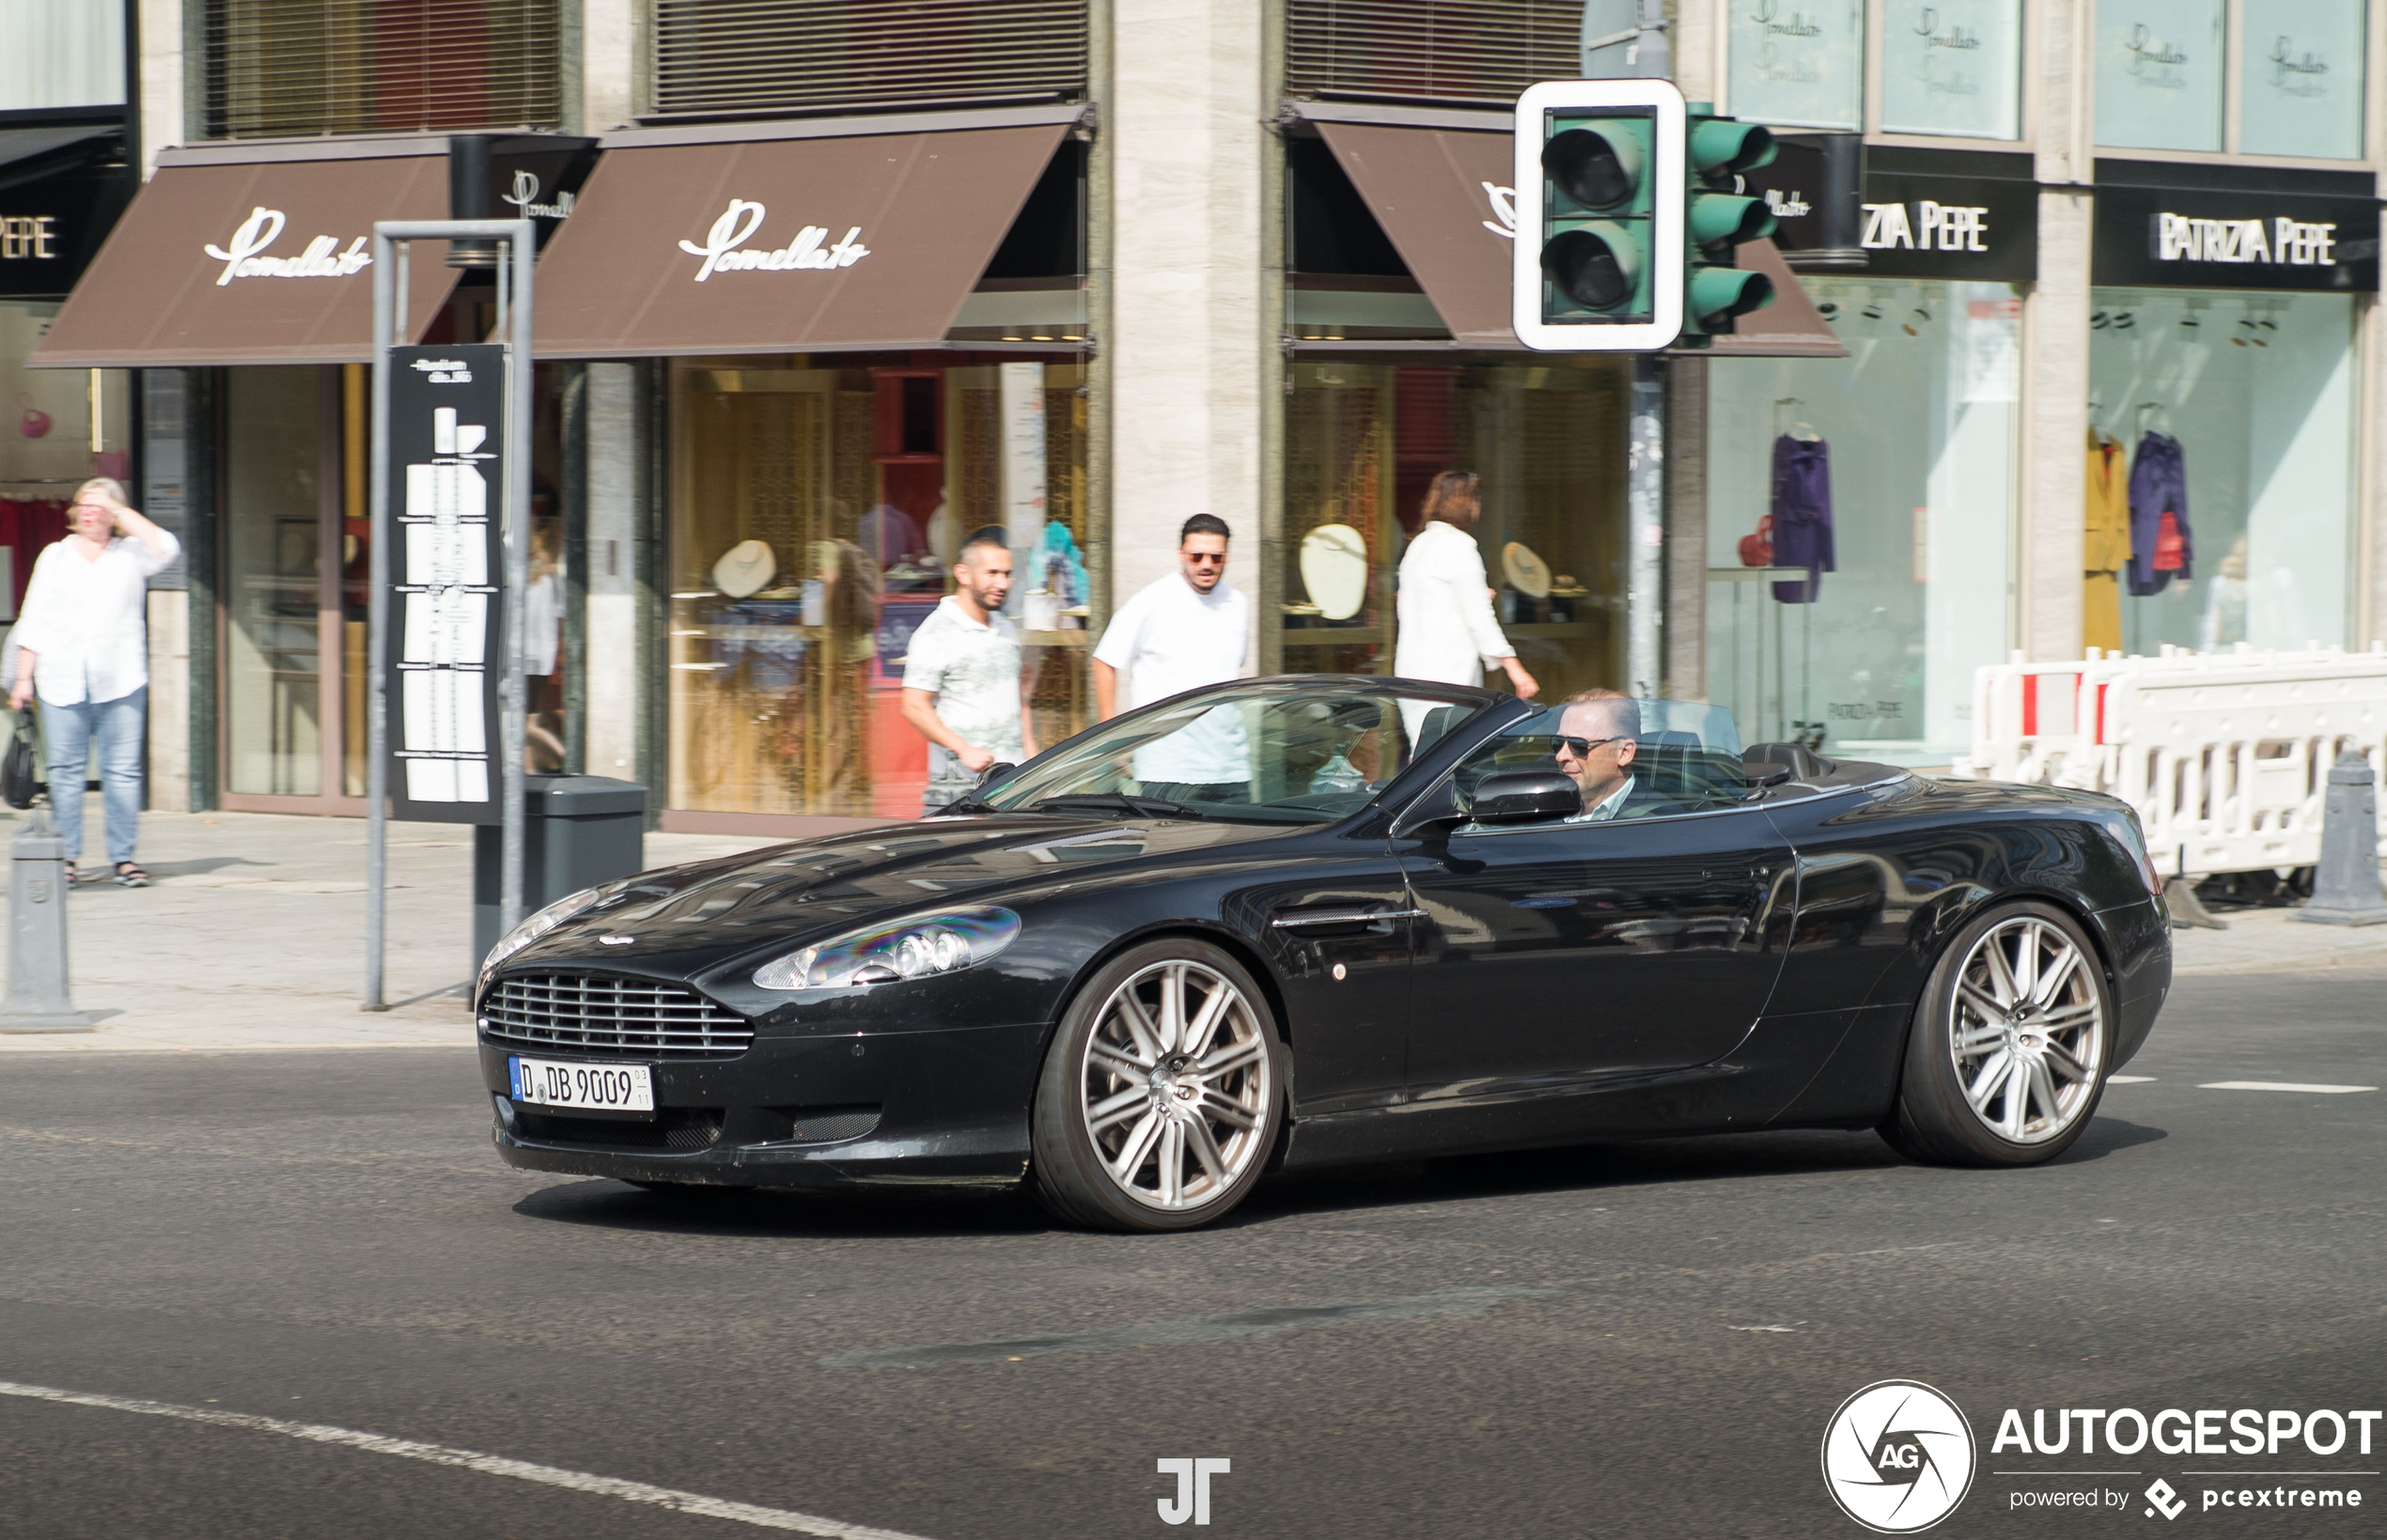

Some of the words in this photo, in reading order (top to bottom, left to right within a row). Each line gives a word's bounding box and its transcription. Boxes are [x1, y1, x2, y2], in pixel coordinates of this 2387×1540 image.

[204, 207, 374, 287] Pomellato
[678, 198, 871, 282] Pomellato
[1860, 203, 1914, 249] ZIA
[1920, 200, 1989, 251] PEPE
[2159, 212, 2271, 263] PATRIZIA
[2274, 217, 2337, 266] PEPE
[522, 1064, 533, 1097] D
[545, 1066, 571, 1101] DB
[577, 1069, 632, 1105] 9009
[634, 1069, 647, 1080] 03
